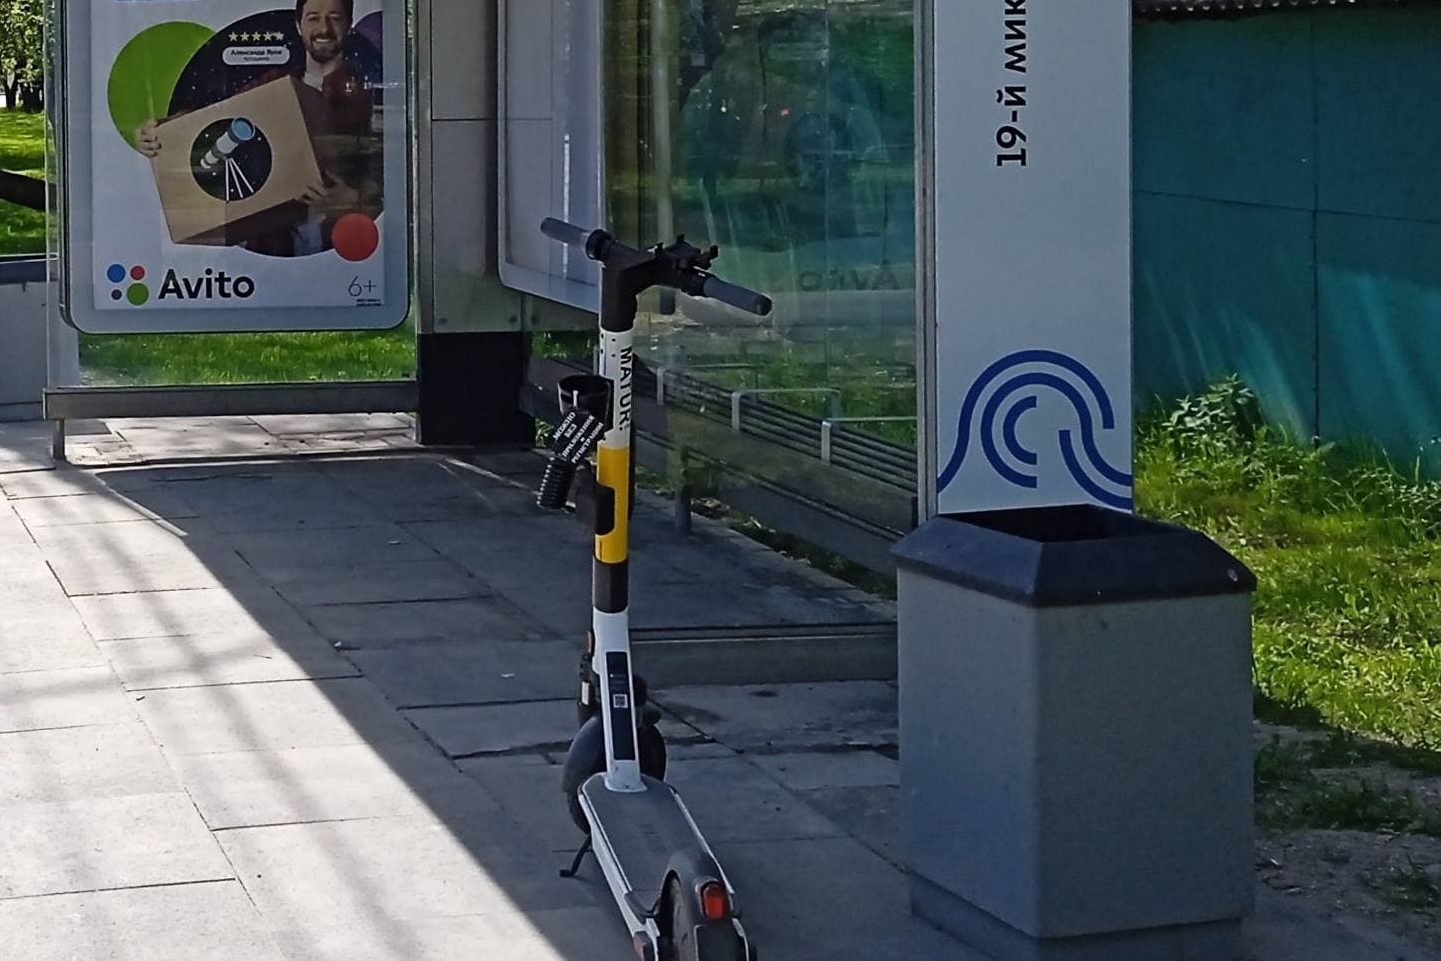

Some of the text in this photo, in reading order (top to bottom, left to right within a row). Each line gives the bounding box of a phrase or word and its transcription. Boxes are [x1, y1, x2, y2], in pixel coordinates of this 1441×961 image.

[996, 86, 1027, 167] 19-й
[158, 267, 256, 301] Avito
[348, 275, 377, 297] 6+
